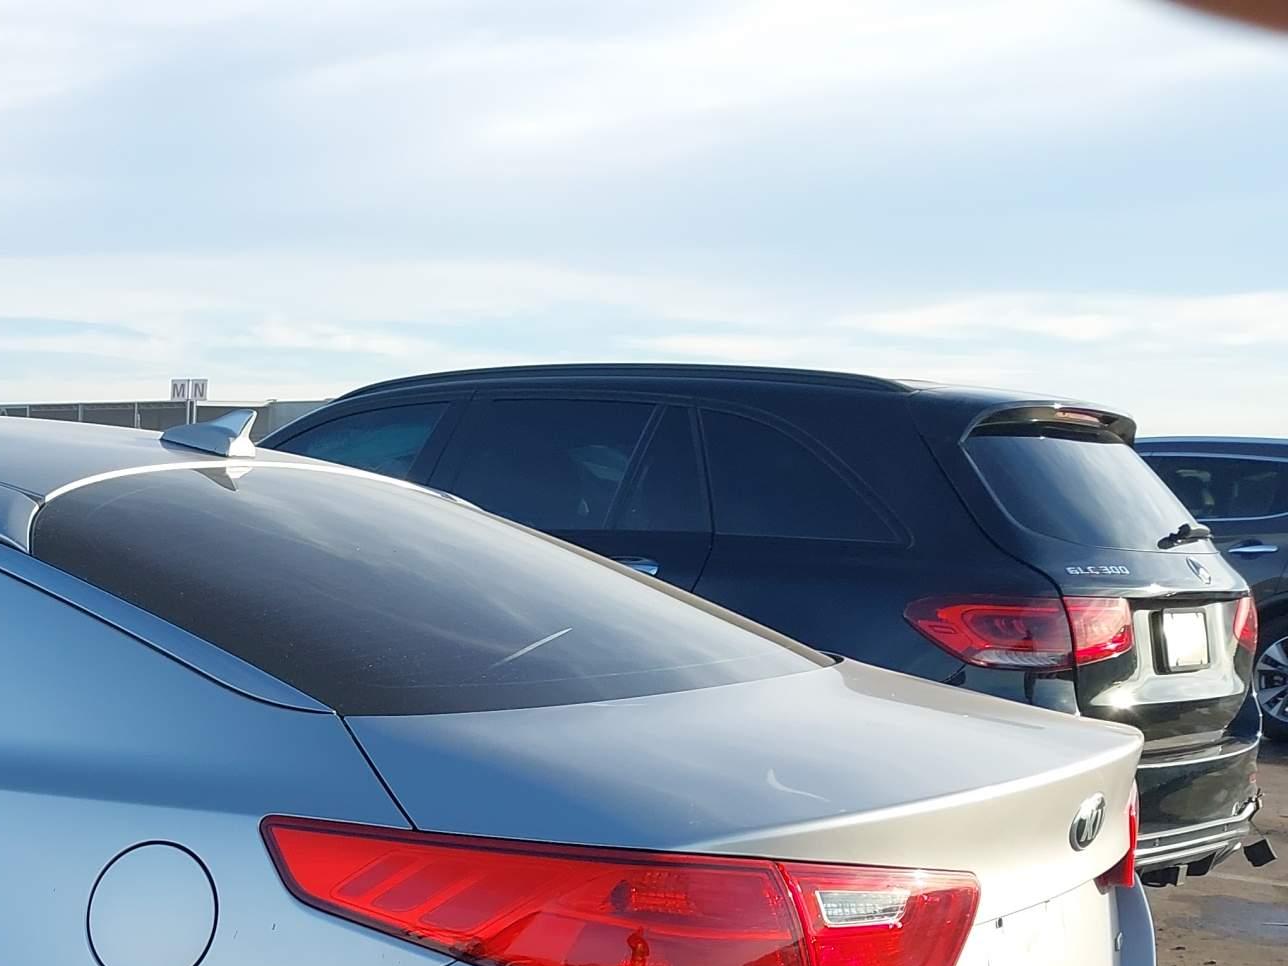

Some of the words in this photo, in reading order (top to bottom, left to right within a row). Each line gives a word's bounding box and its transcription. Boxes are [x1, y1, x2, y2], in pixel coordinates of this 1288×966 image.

[173, 383, 185, 398] M
[194, 383, 205, 398] N
[1065, 566, 1100, 575] GLC
[1099, 565, 1130, 574] 300
